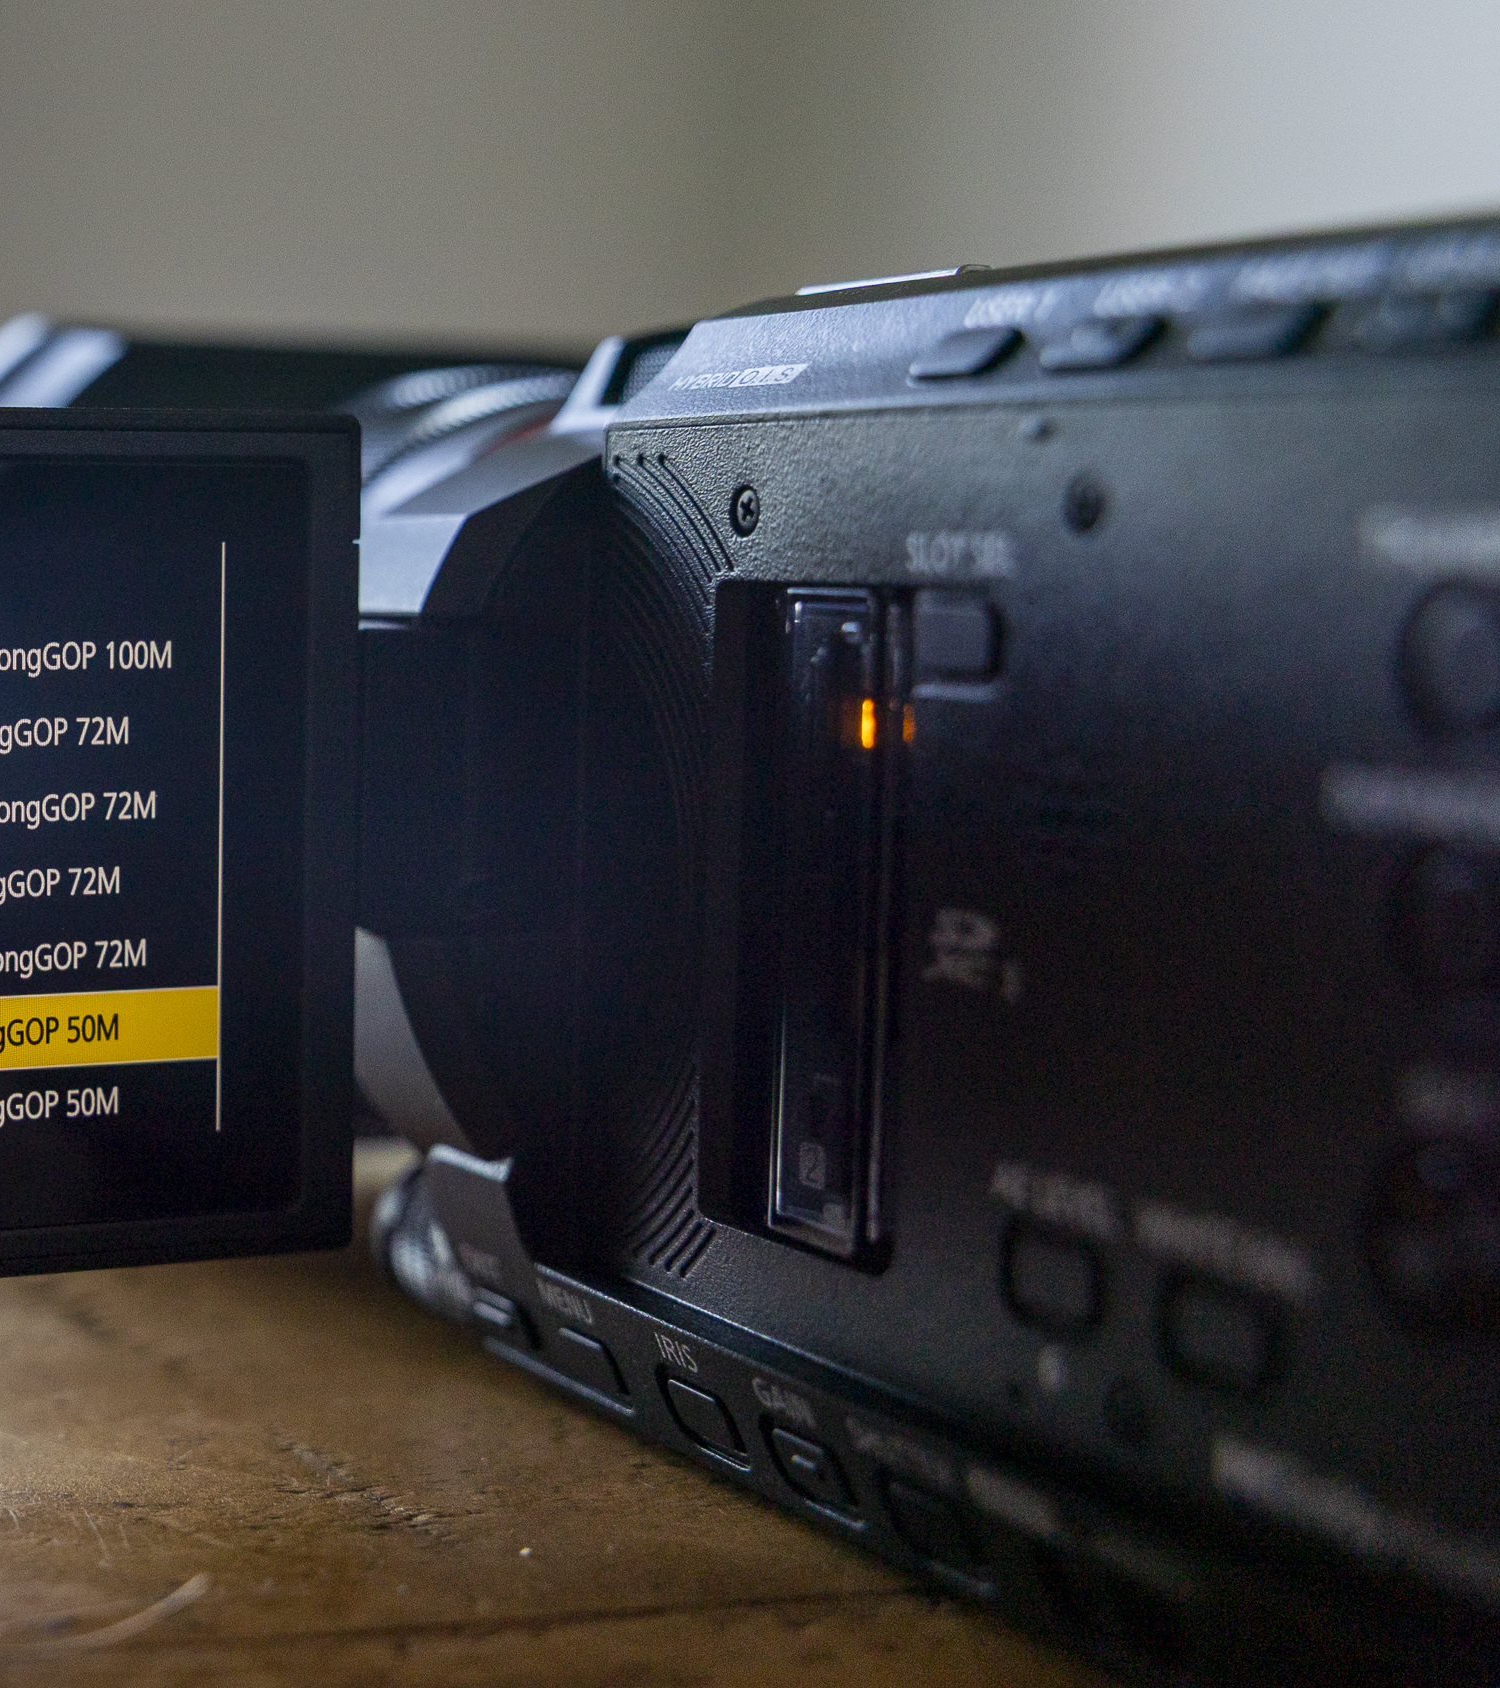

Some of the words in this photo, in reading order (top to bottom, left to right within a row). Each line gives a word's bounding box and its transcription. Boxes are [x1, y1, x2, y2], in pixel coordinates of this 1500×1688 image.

[666, 370, 741, 392] HYBRID
[105, 640, 173, 671] 100M
[76, 716, 130, 746] 72M
[103, 790, 157, 821] 72M
[67, 866, 121, 896] 72M
[94, 938, 148, 969] 72M
[66, 1013, 120, 1044] 50M
[65, 1086, 120, 1118] 50M
[535, 1276, 594, 1326] MENU
[654, 1330, 699, 1375] IRIS
[751, 1376, 817, 1430] GAIN
